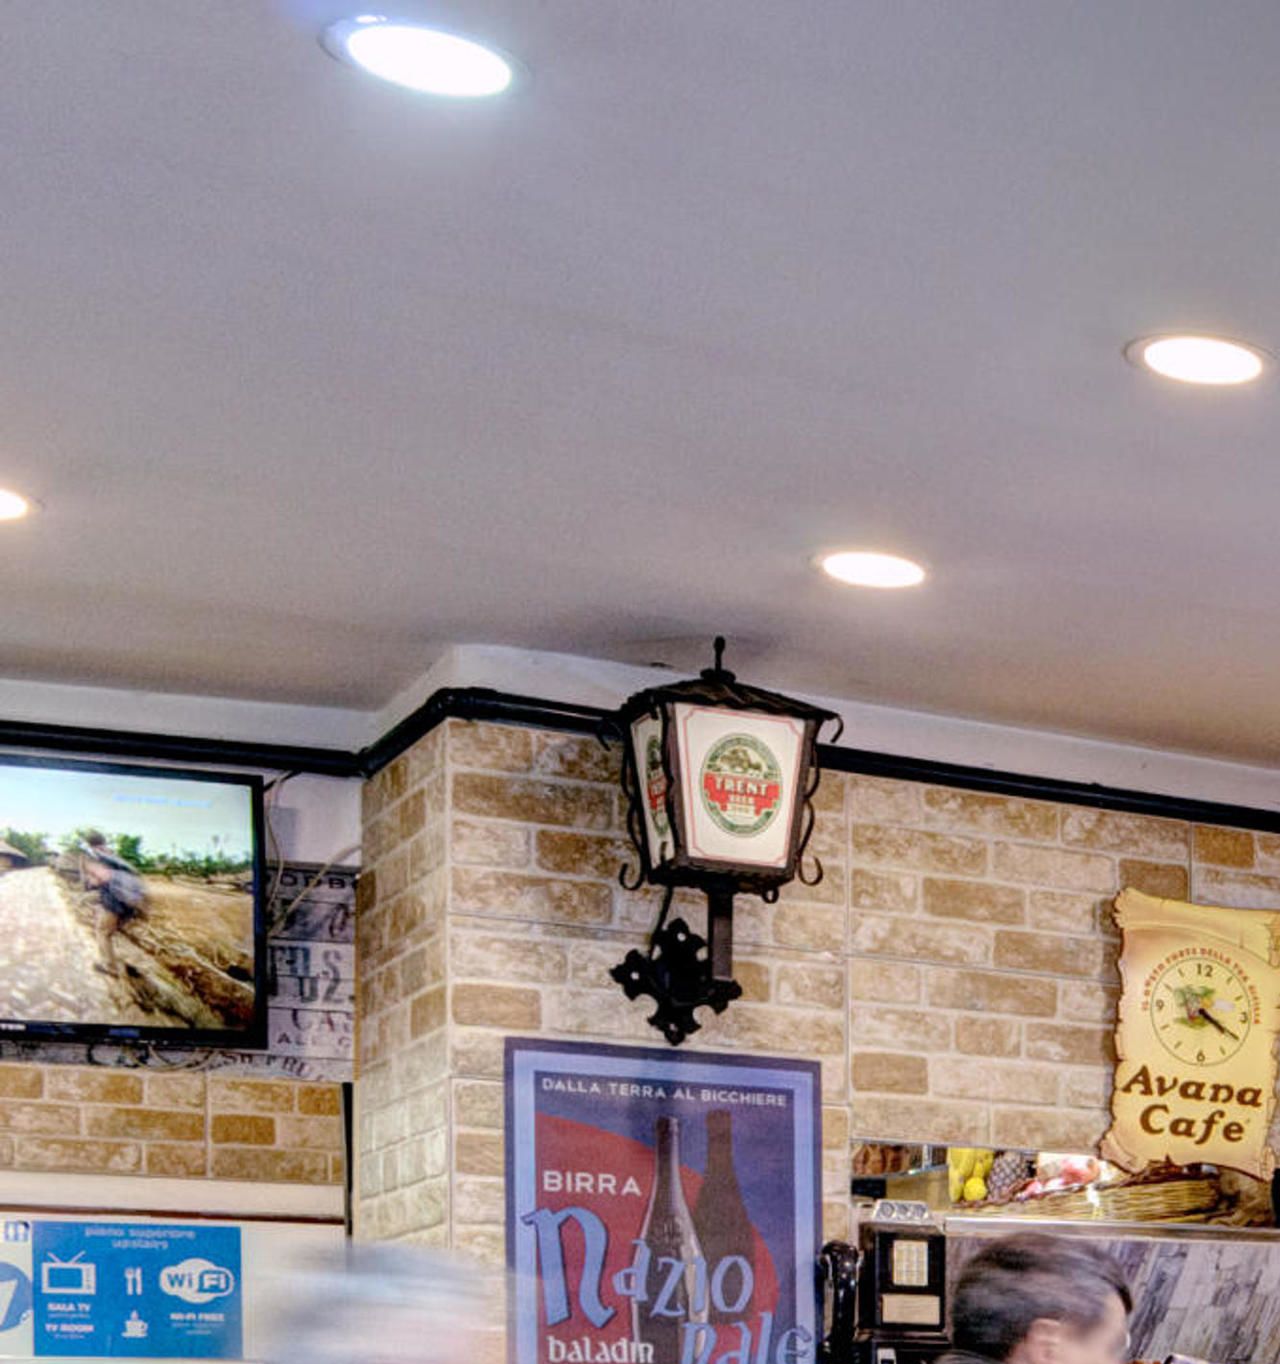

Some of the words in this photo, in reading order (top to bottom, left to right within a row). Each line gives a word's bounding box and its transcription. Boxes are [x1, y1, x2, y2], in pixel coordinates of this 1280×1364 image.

[1196, 963, 1214, 978] 12
[1196, 1050, 1206, 1063] 6
[542, 1077, 601, 1094] DALLA
[609, 1082, 667, 1100] TERRA
[673, 1087, 696, 1101] AL
[701, 1089, 788, 1108] BICCHIERE
[1121, 1065, 1263, 1108] Avana
[542, 1170, 643, 1197] BIRRA
